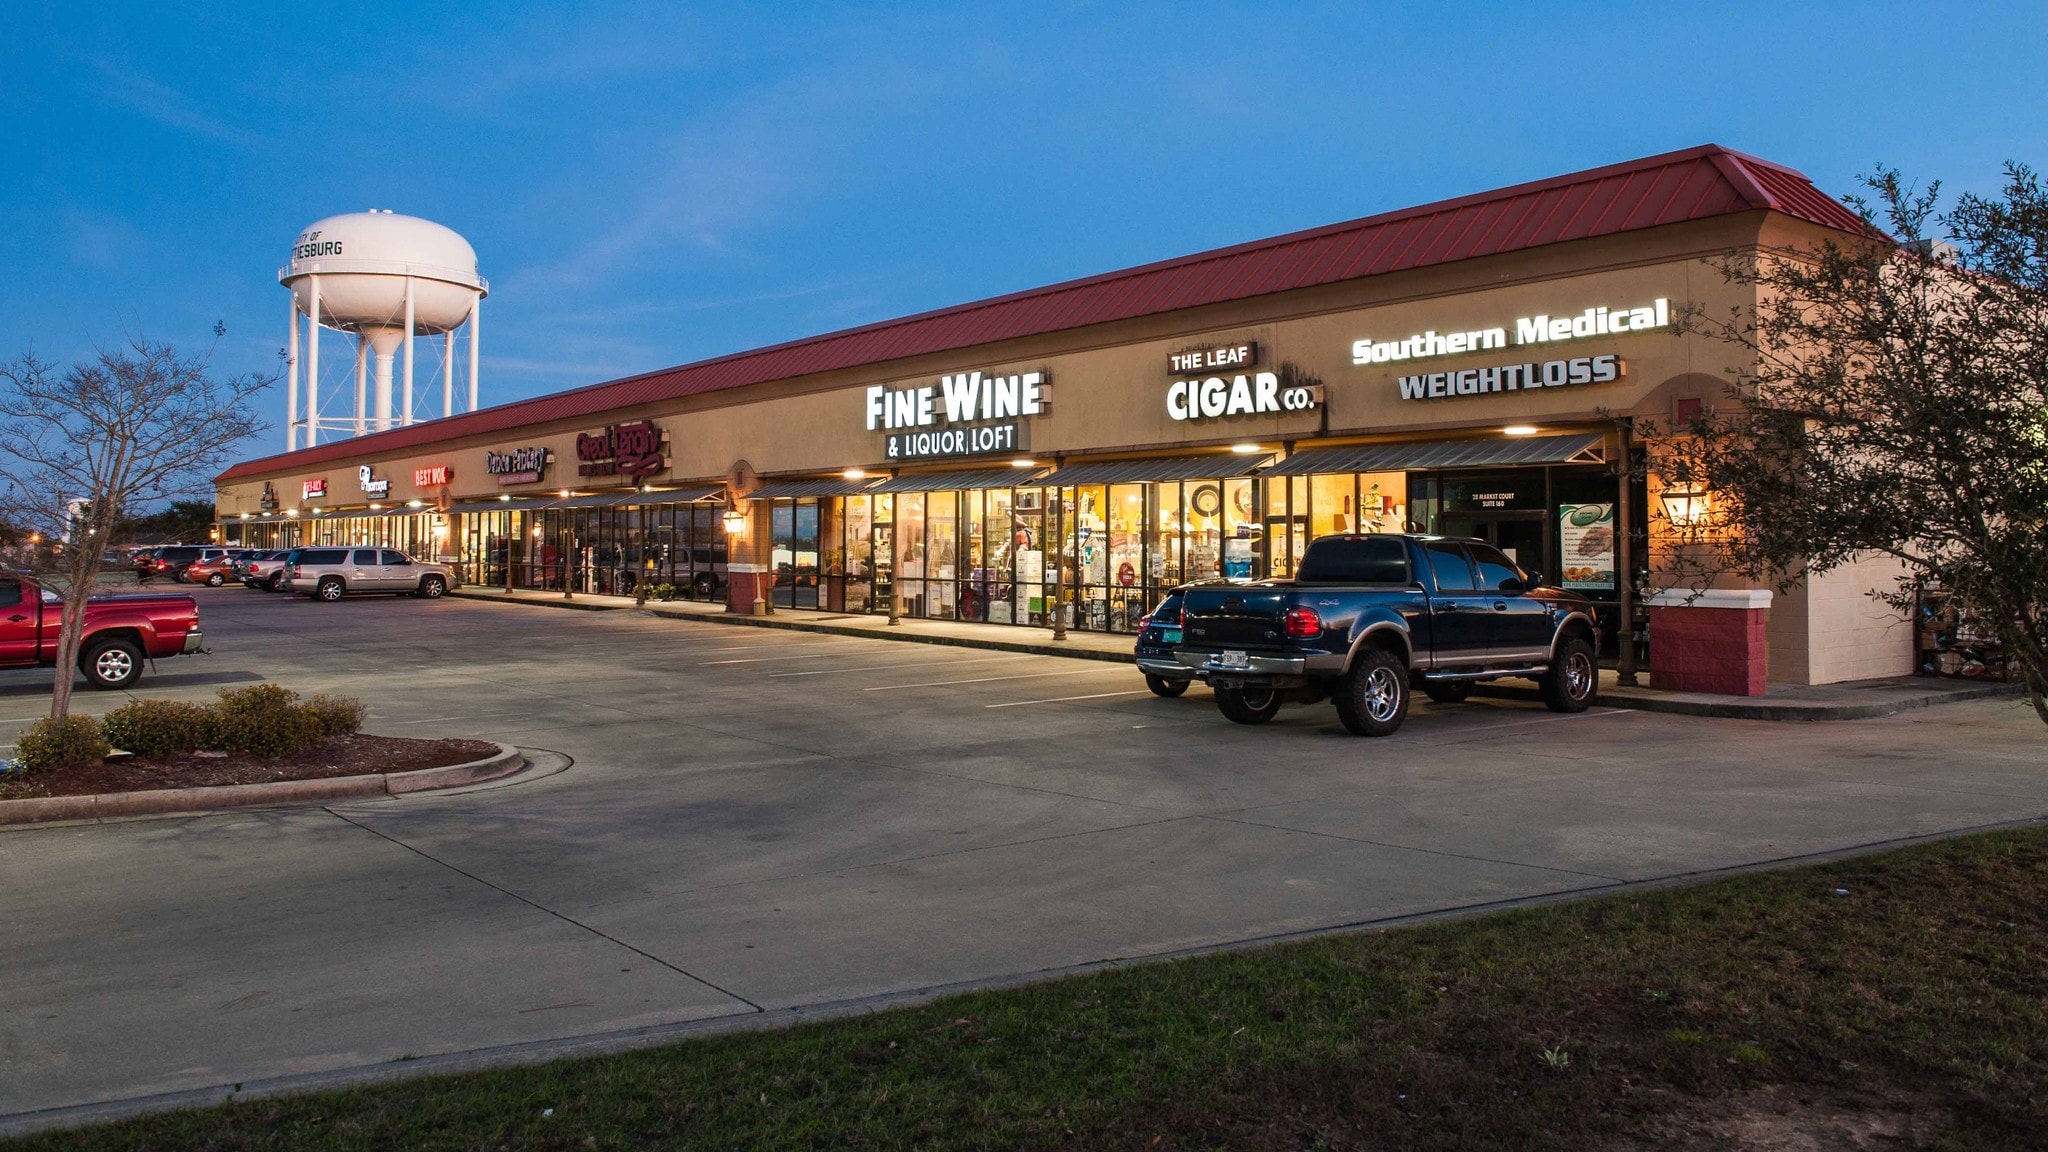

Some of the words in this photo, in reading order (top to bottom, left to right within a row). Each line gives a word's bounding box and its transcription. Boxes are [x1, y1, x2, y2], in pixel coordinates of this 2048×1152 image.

[310, 231, 322, 241] OF
[1352, 327, 1506, 366] Southern
[1516, 298, 1669, 345] Medical
[1171, 352, 1202, 371] THE
[1206, 346, 1248, 367] LEAF
[1398, 354, 1618, 400] WEIGHTLOSS
[1166, 372, 1281, 421] CIGAR
[1283, 388, 1315, 411] CO.
[888, 436, 899, 457] &
[905, 430, 964, 456] LIQUOR
[972, 425, 1014, 452] LOFT
[415, 469, 431, 486] BEST
[432, 466, 447, 484] WOK
